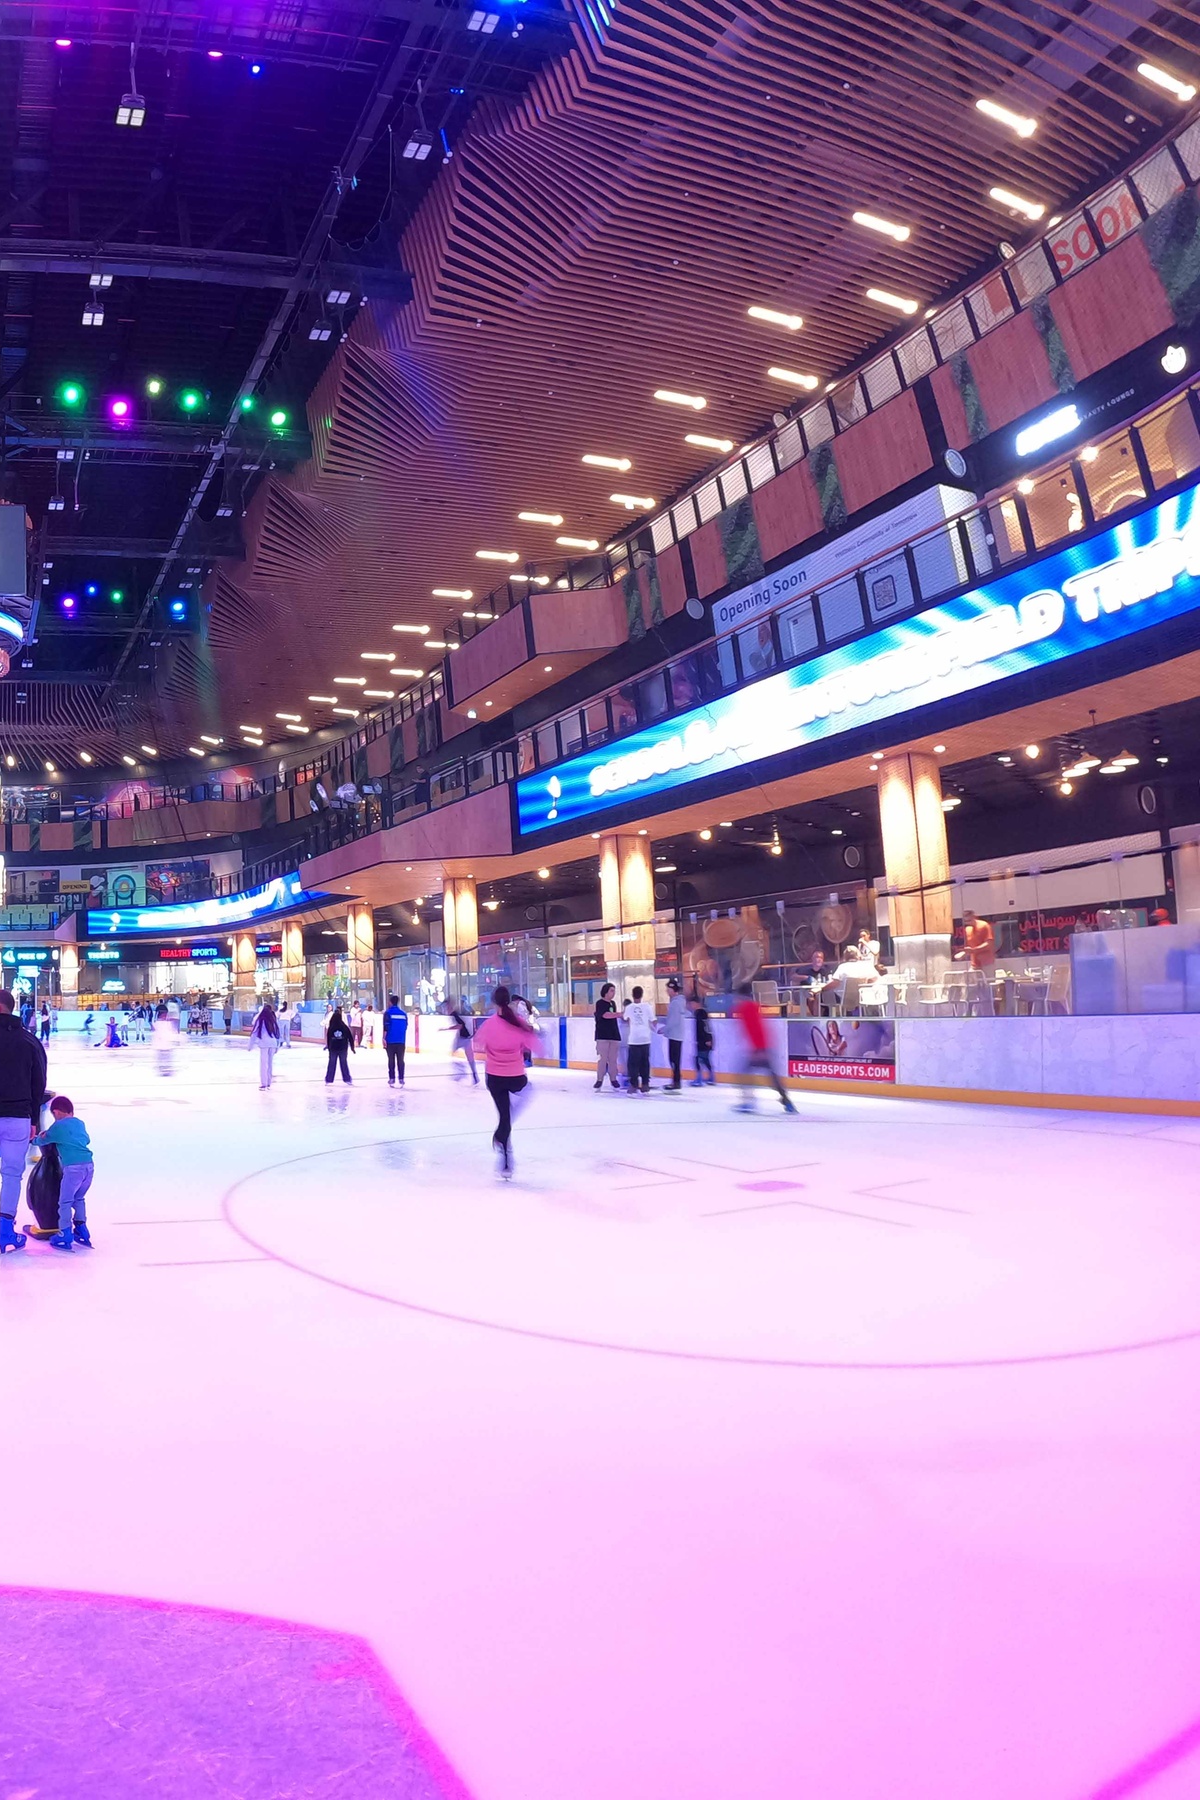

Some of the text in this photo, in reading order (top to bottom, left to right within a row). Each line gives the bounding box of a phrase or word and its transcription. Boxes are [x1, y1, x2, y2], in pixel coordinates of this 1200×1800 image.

[719, 568, 807, 622] Opening Soon
[1020, 936, 1060, 952] SPORT
[160, 947, 218, 958] HEALTHY SPORTS
[792, 1062, 890, 1078] LEADERSPORTS.COM
